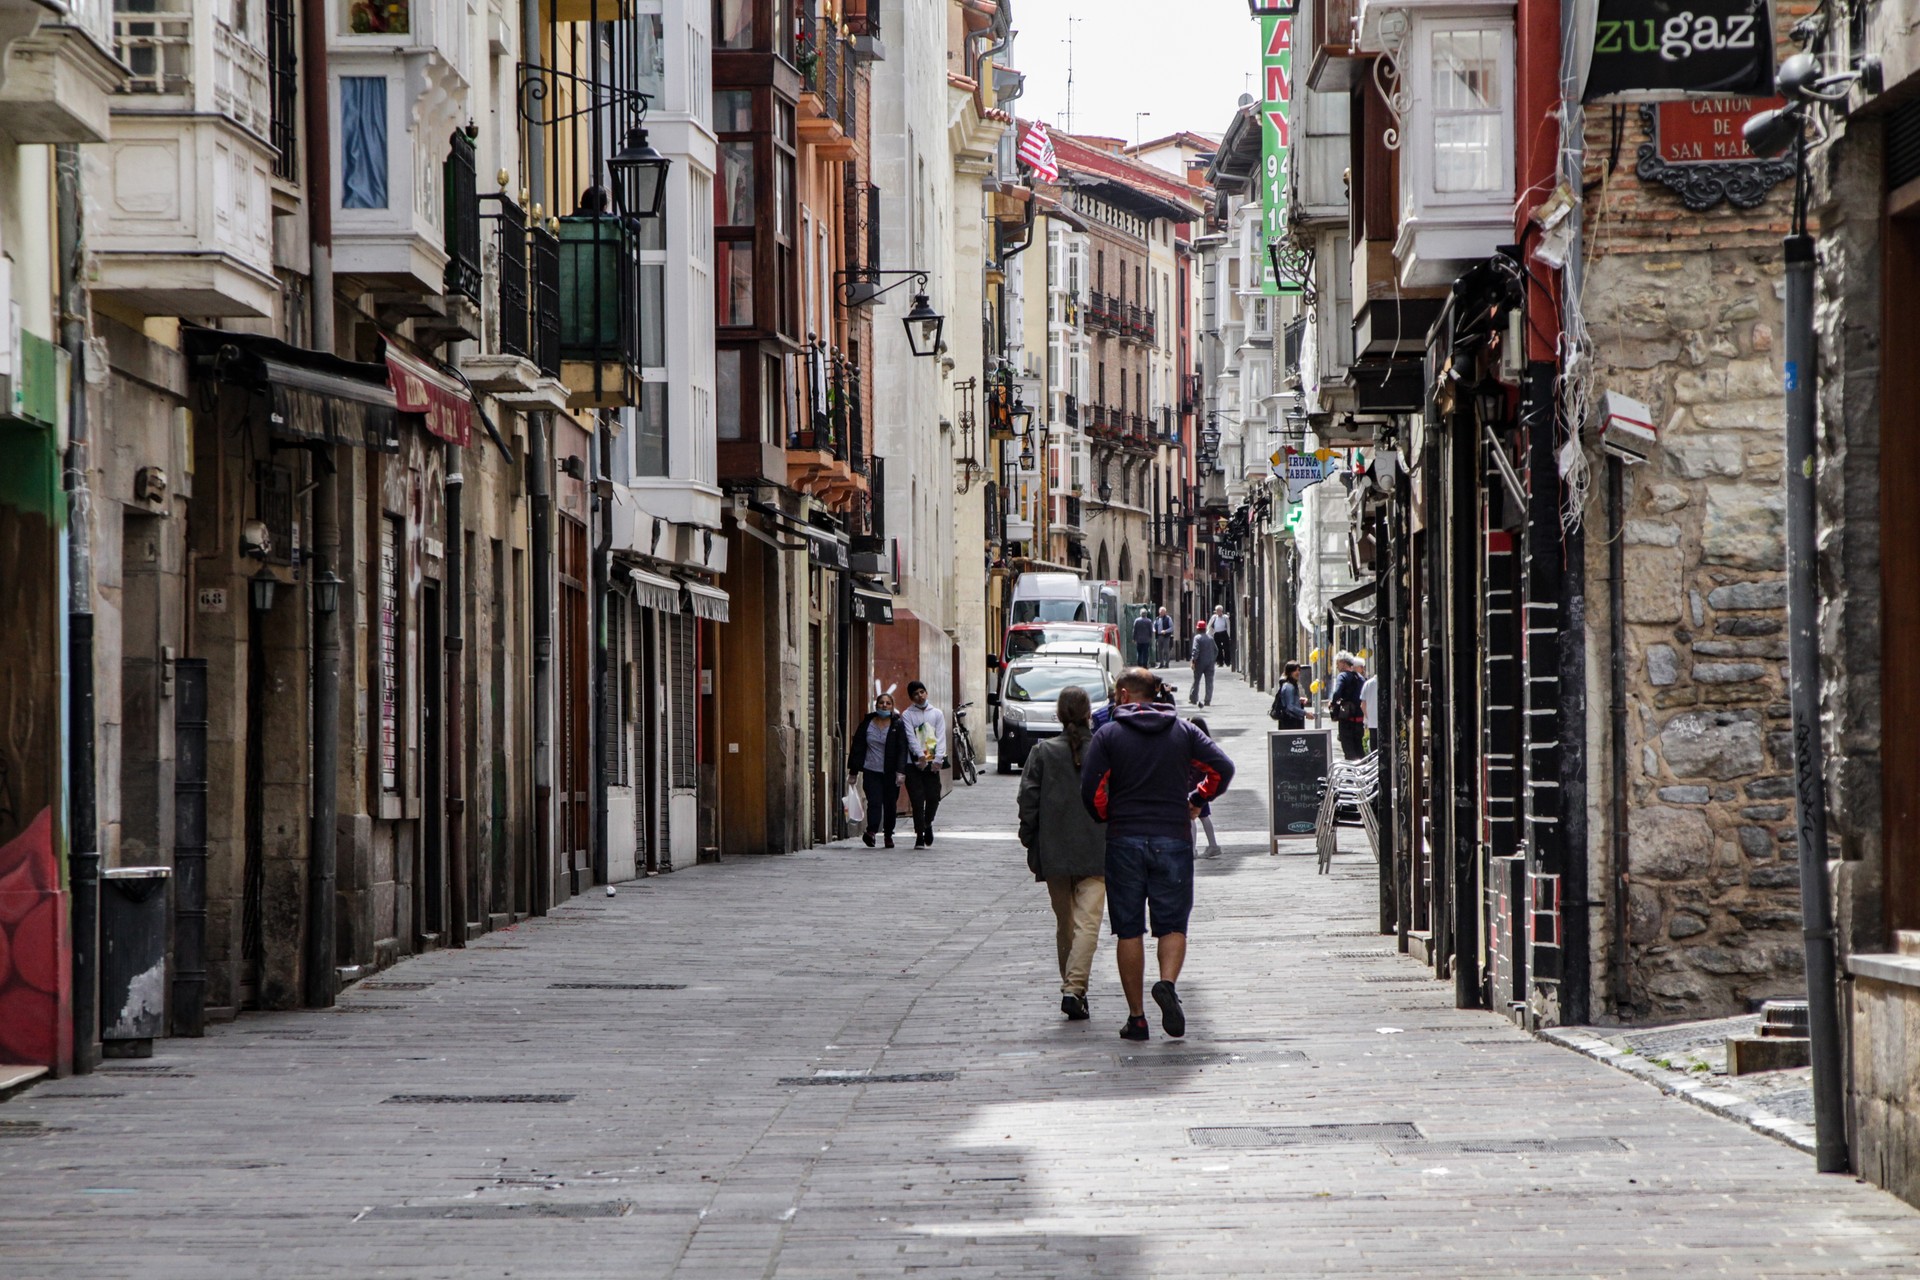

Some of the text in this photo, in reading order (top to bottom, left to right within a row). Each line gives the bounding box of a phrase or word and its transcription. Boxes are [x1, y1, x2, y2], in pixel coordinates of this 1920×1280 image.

[1596, 11, 1755, 61] zugaz
[1714, 119, 1731, 135] DE
[1671, 143, 1702, 159] SAN
[1289, 454, 1318, 467] IRUÑA
[1286, 469, 1322, 479] TABERNA
[201, 592, 223, 605] 68
